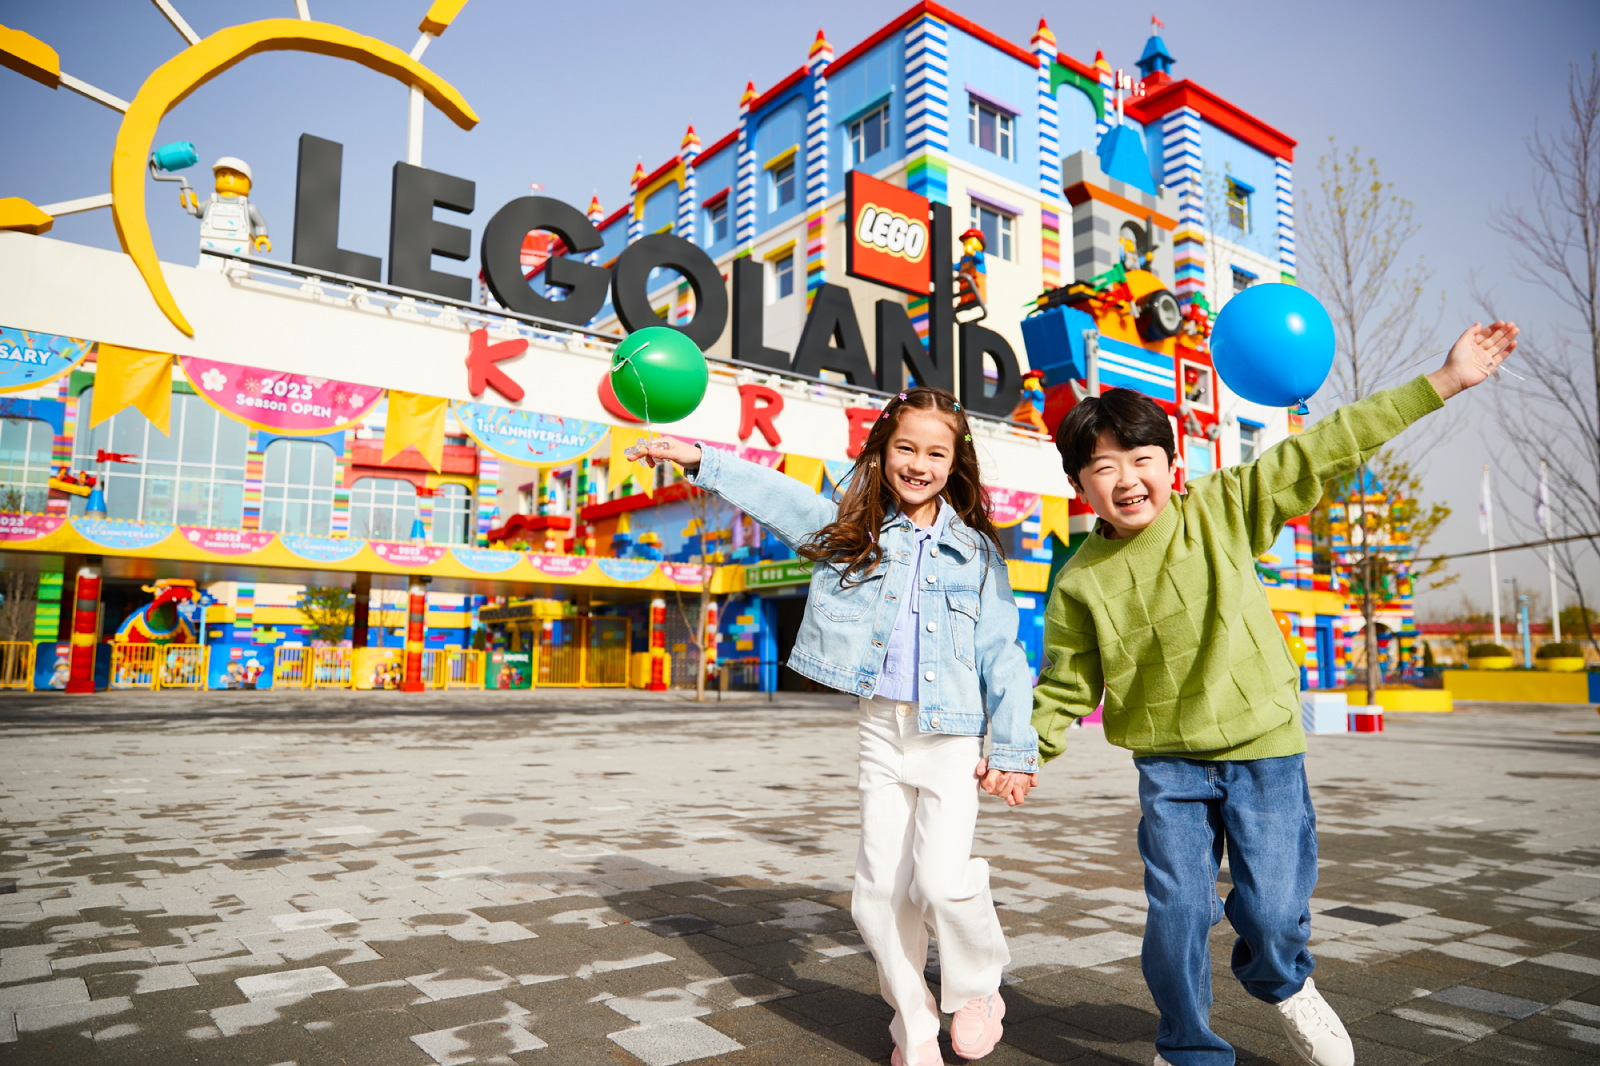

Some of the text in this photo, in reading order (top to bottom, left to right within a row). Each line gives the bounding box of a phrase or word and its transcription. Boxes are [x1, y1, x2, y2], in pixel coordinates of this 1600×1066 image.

[858, 206, 926, 259] LEGO
[292, 132, 1021, 418] LEGOLAND
[260, 378, 313, 400] 2023
[235, 393, 331, 419] Season OPEN
[476, 418, 586, 447] 1st ANNIVERSARY
[0, 516, 24, 527] 023
